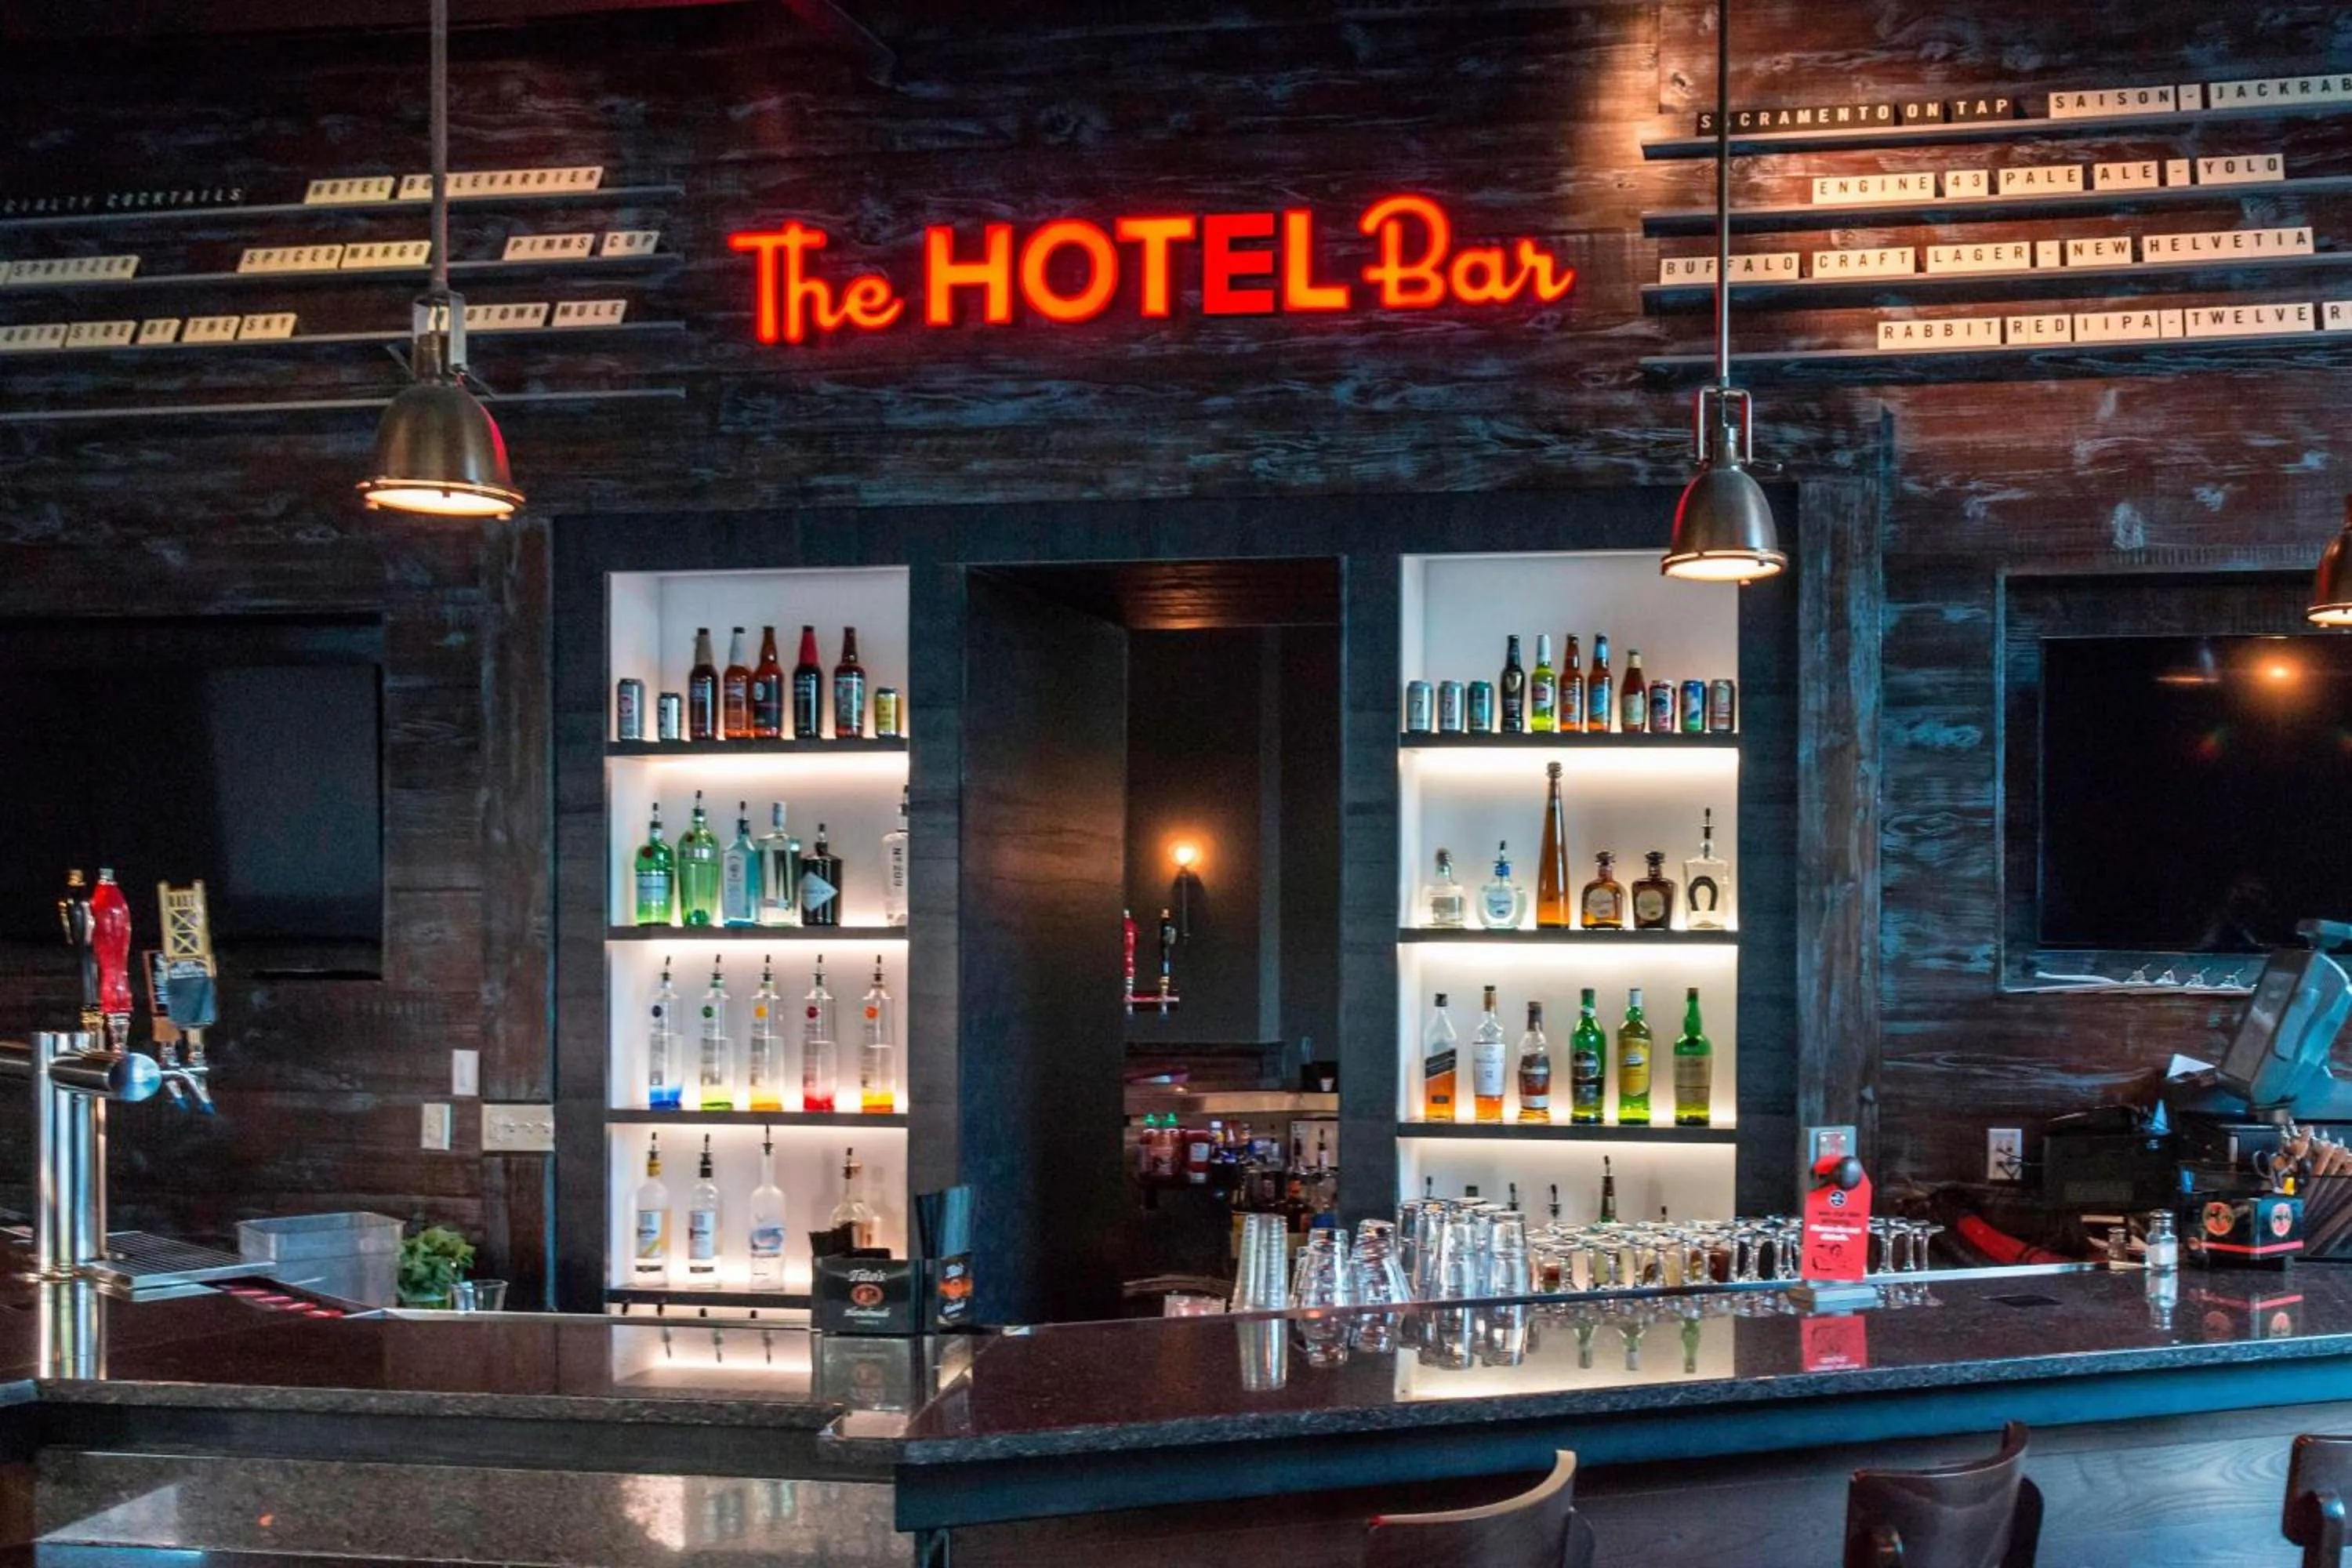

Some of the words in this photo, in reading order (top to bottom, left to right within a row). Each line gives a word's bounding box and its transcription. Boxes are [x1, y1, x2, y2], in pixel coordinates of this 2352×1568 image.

[2056, 89, 2169, 109] SAISON
[2217, 78, 2352, 99] JACKRAB
[1700, 105, 1889, 129] SCRAMENTO
[1906, 103, 1939, 118] ON
[1956, 99, 2008, 115] TAP
[313, 179, 386, 196] HOTEL
[406, 169, 597, 191] BOLEVARDIER
[1820, 176, 1926, 195] ENGINE
[1951, 174, 1980, 188] 43
[2006, 169, 2076, 186] PALE
[2100, 165, 2151, 180] ALE
[2204, 156, 2278, 175] YOLO
[106, 187, 243, 209] COCKTAILS
[246, 248, 336, 265] SPICED
[511, 235, 588, 252] PIMMS
[607, 233, 654, 248] CUP
[1820, 252, 1907, 269] CRAFT
[1935, 242, 2024, 263] LAGER
[2074, 240, 2128, 256] NEW
[2150, 232, 2307, 252] HELVETIA
[728, 223, 905, 344] The
[924, 207, 1350, 326] HOTEL
[1359, 194, 1574, 312] Bar
[561, 302, 621, 318] MULE
[1884, 321, 1993, 339] RABBIT
[2013, 318, 2064, 334] RED
[2083, 314, 2153, 332] IIPA
[2193, 307, 2307, 326] TWELVE
[146, 322, 172, 336] OF
[190, 320, 231, 335] THE
[246, 316, 289, 331] SKY
